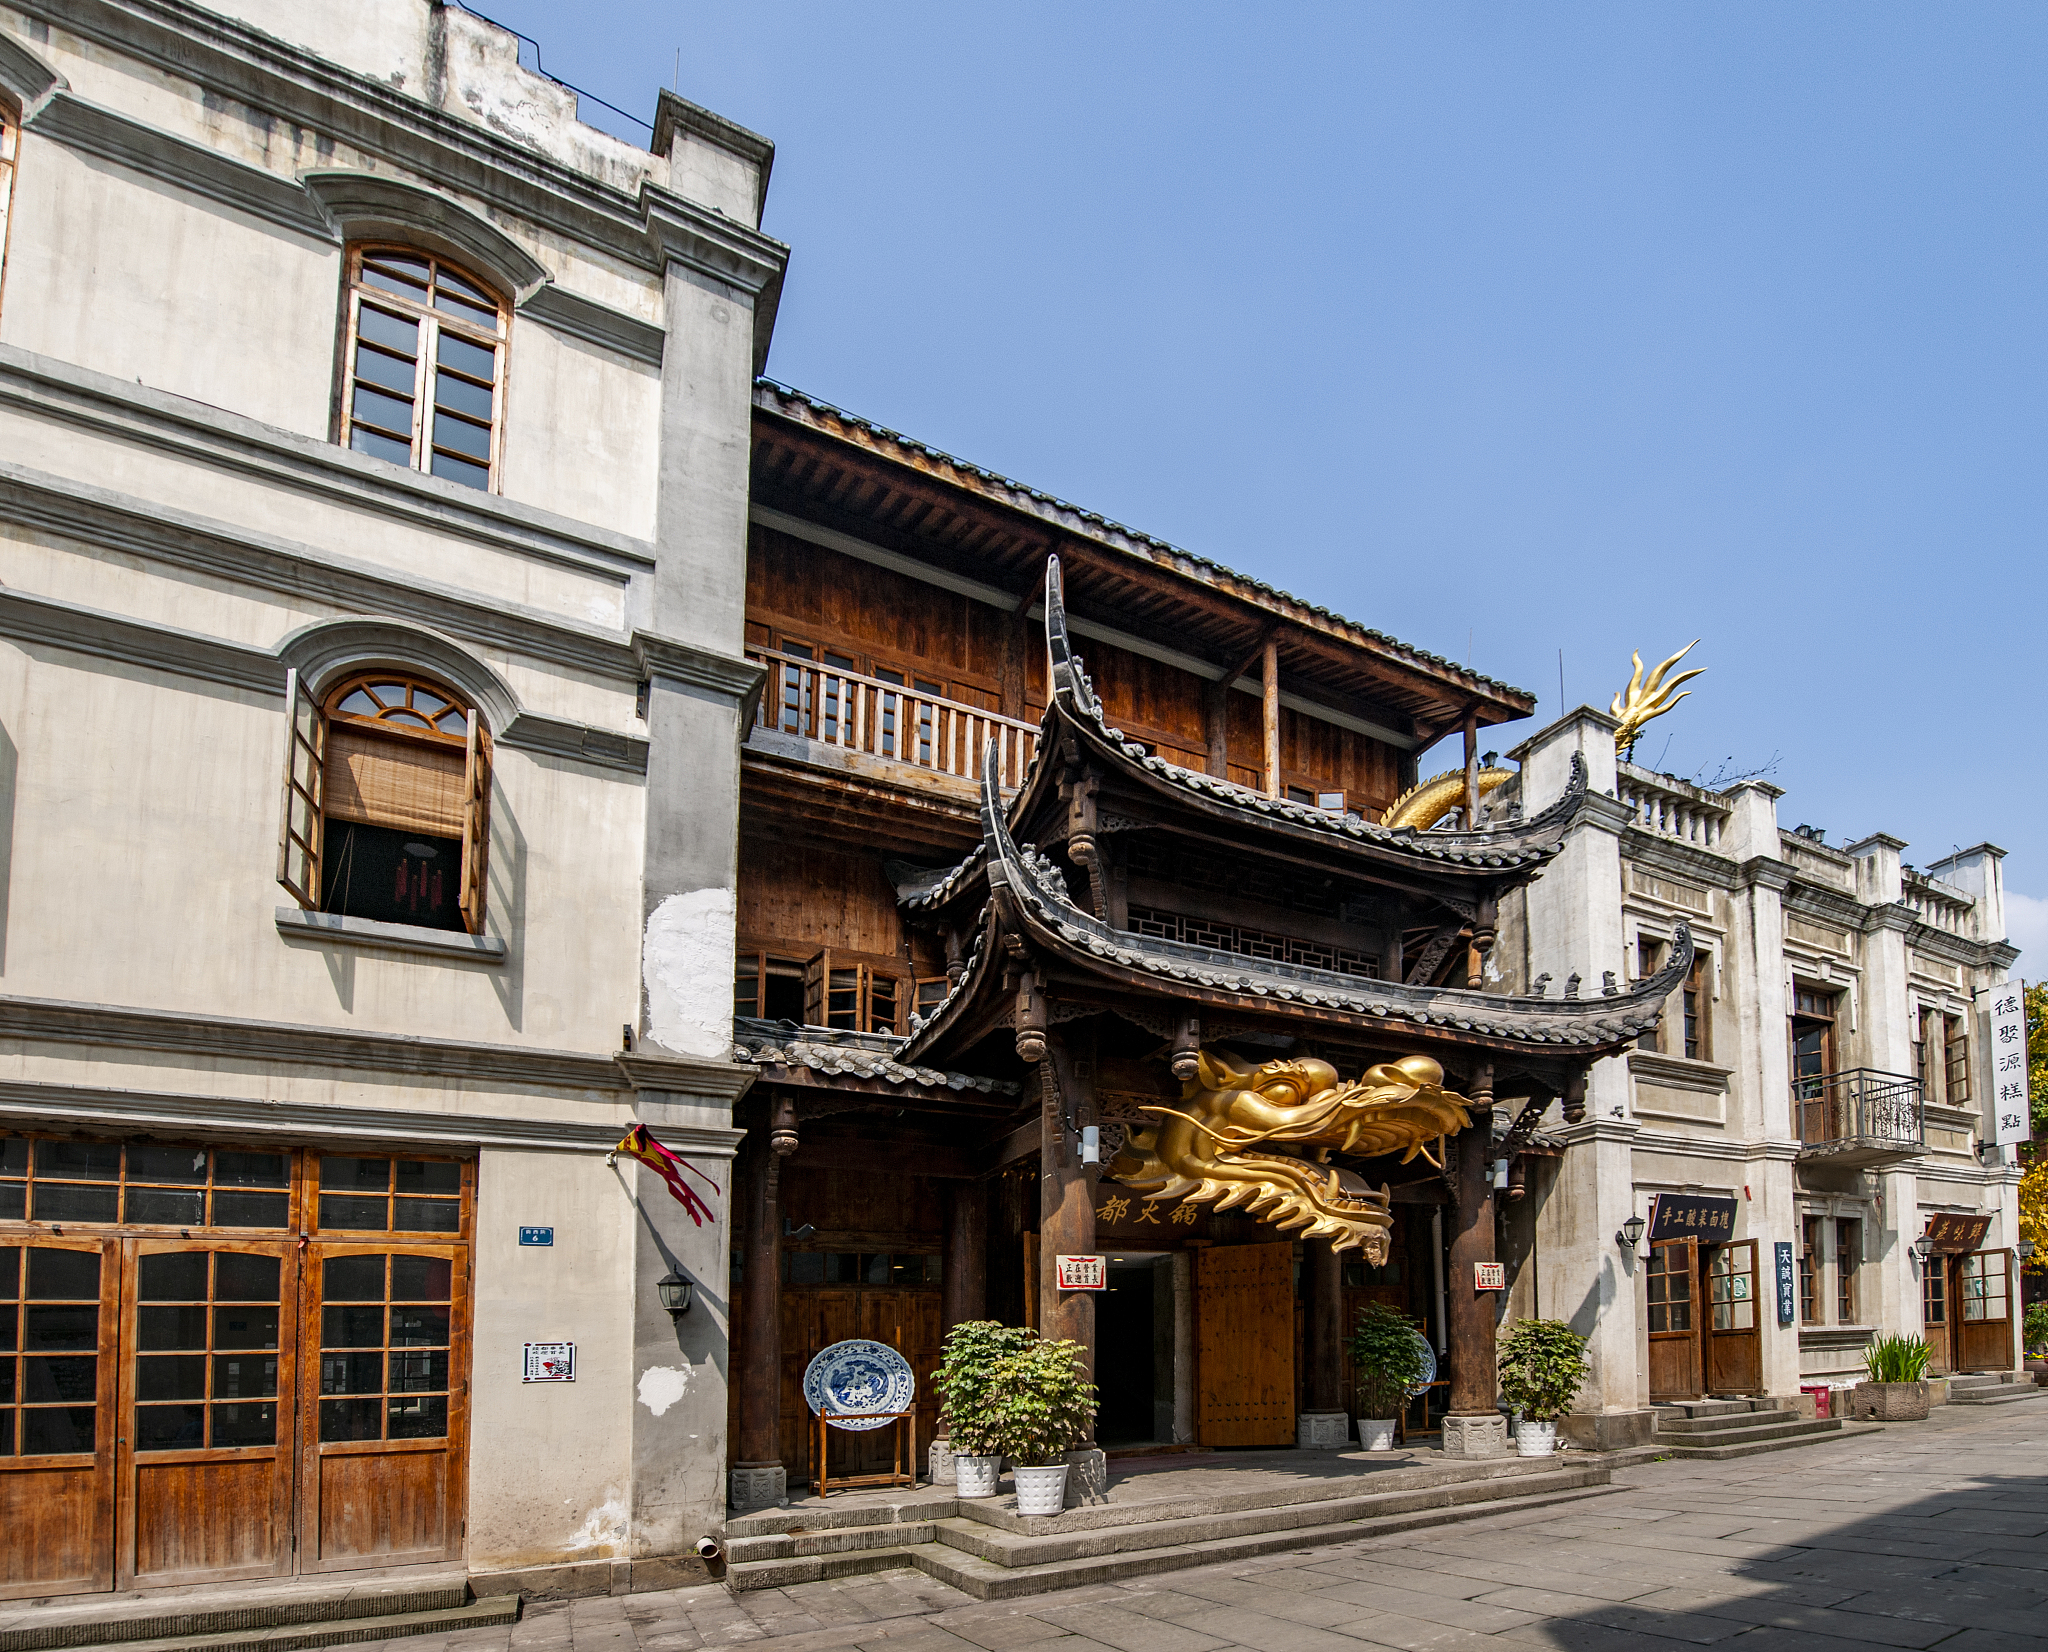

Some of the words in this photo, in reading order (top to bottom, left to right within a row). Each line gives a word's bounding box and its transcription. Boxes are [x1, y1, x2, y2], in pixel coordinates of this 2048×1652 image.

[1995, 996, 2023, 1131] 德聚源糕點
